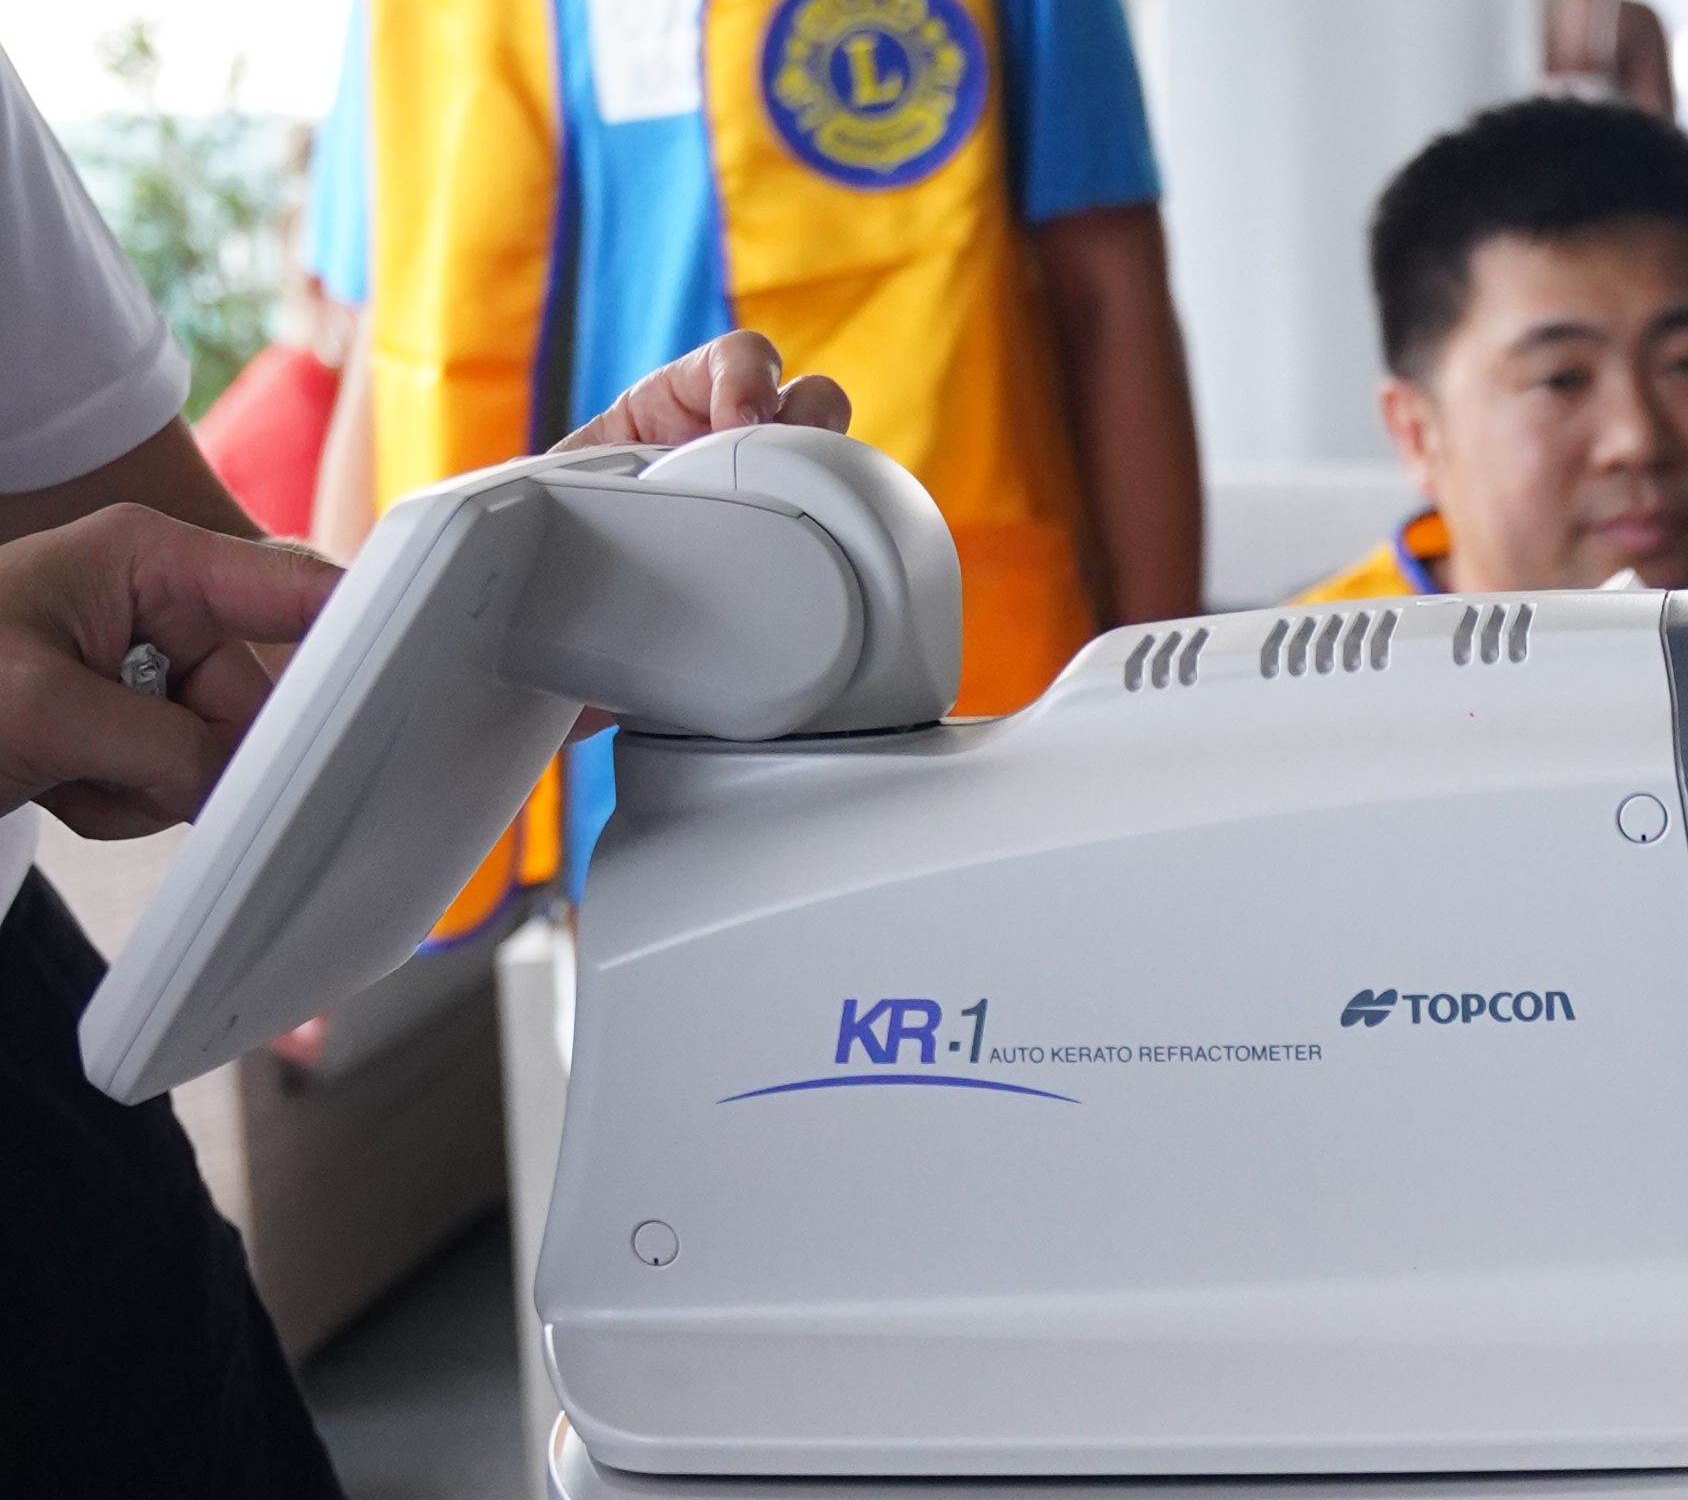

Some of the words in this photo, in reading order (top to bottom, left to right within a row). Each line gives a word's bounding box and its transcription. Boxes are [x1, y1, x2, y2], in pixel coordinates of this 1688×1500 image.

[844, 34, 904, 106] L
[1403, 990, 1576, 1026] TOPCON
[988, 1046, 1044, 1065] AUTO
[1051, 1045, 1132, 1064] KERATO
[1140, 1043, 1322, 1064] REFRACTOMETER
